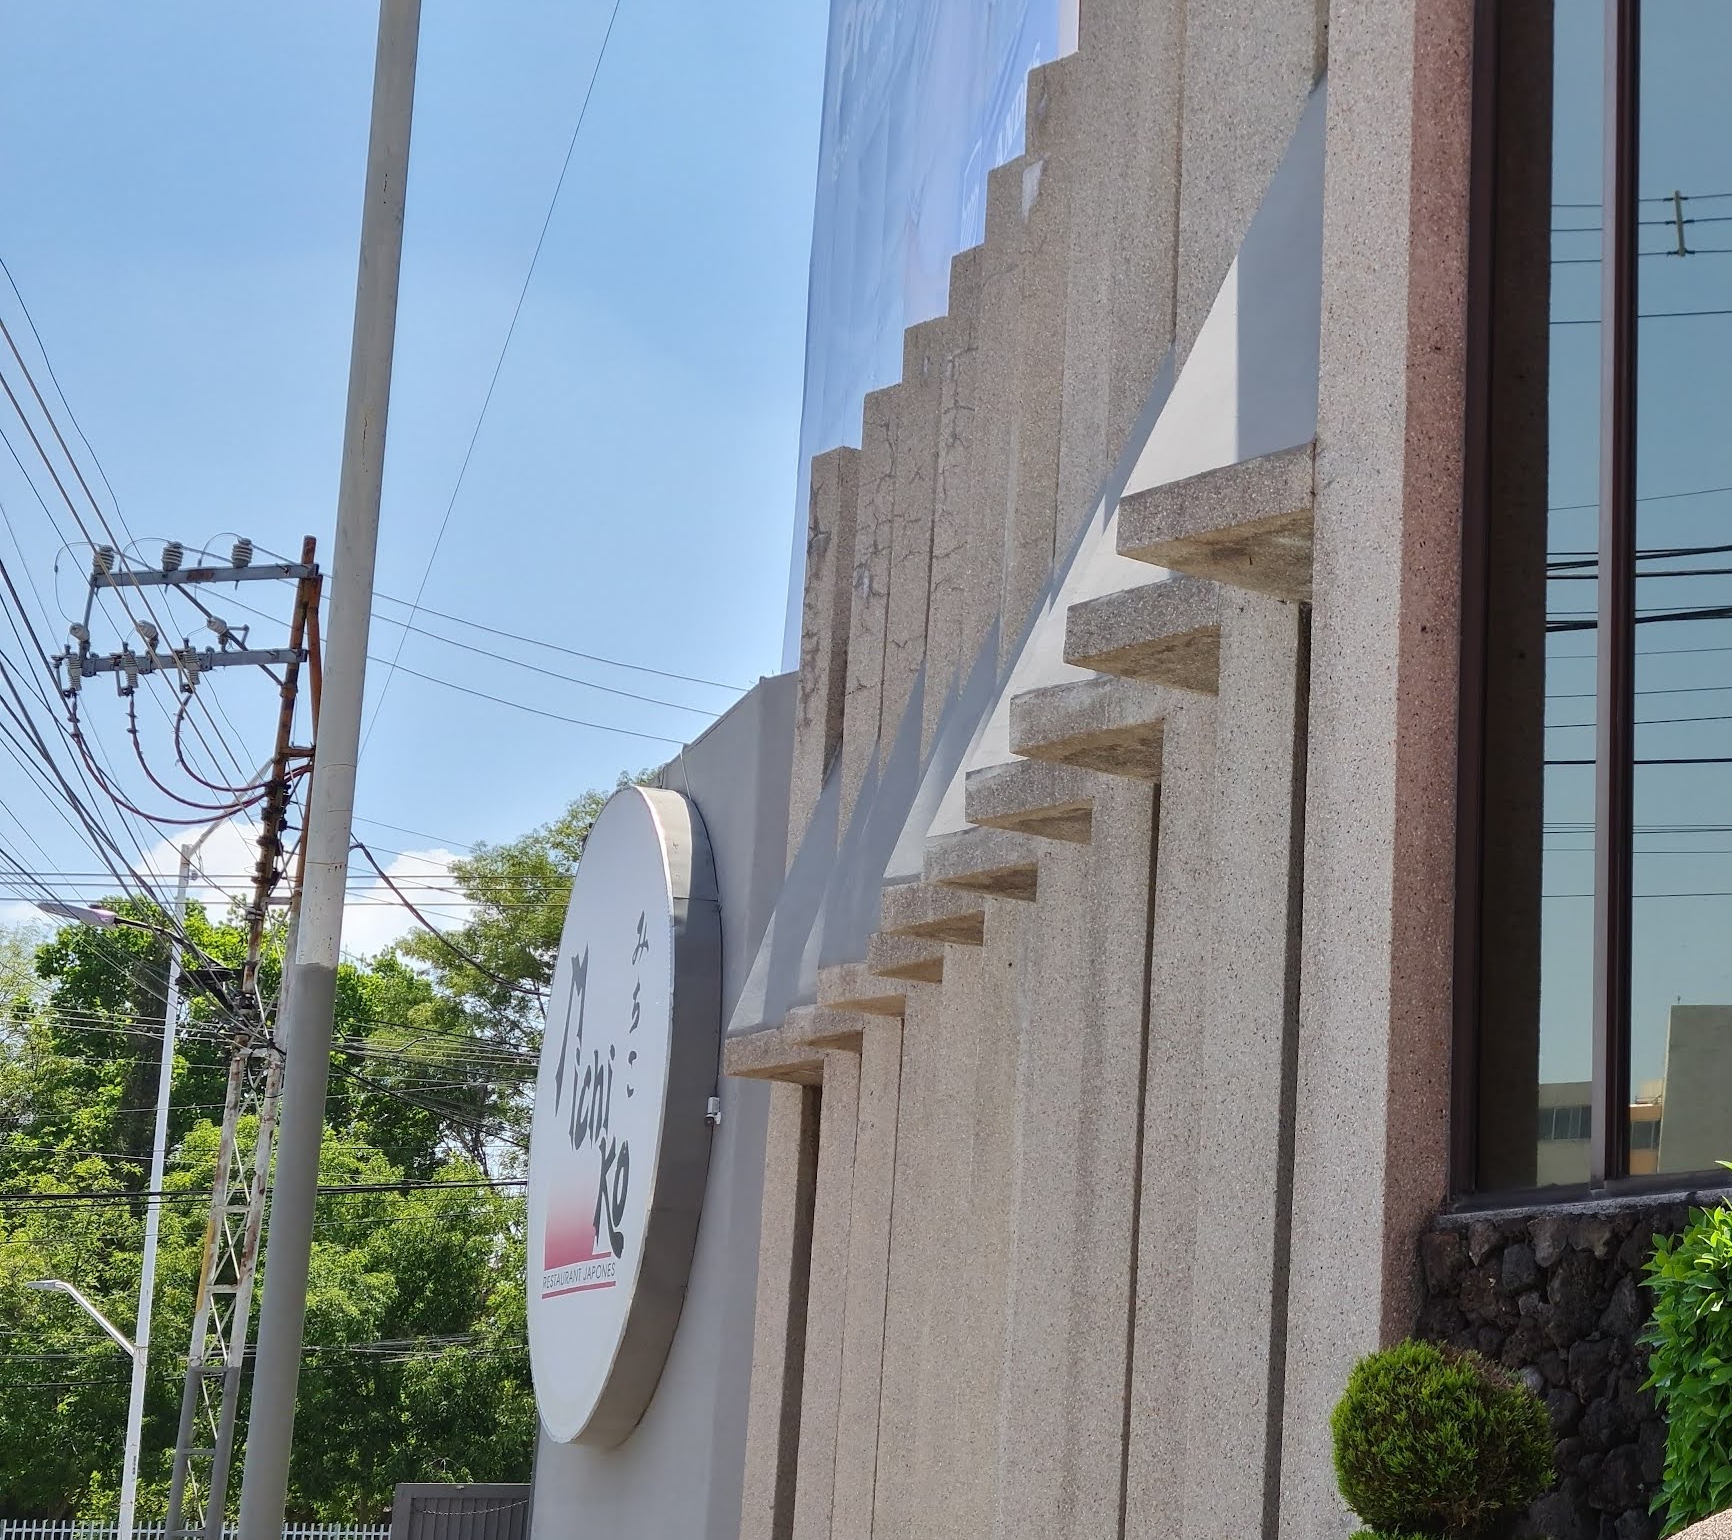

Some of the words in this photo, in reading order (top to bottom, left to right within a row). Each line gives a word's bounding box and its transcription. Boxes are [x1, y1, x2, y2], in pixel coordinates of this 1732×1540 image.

[555, 941, 616, 1151] Michi
[542, 1268, 581, 1289] RESTAURANT
[582, 1262, 616, 1281] JAPONES
